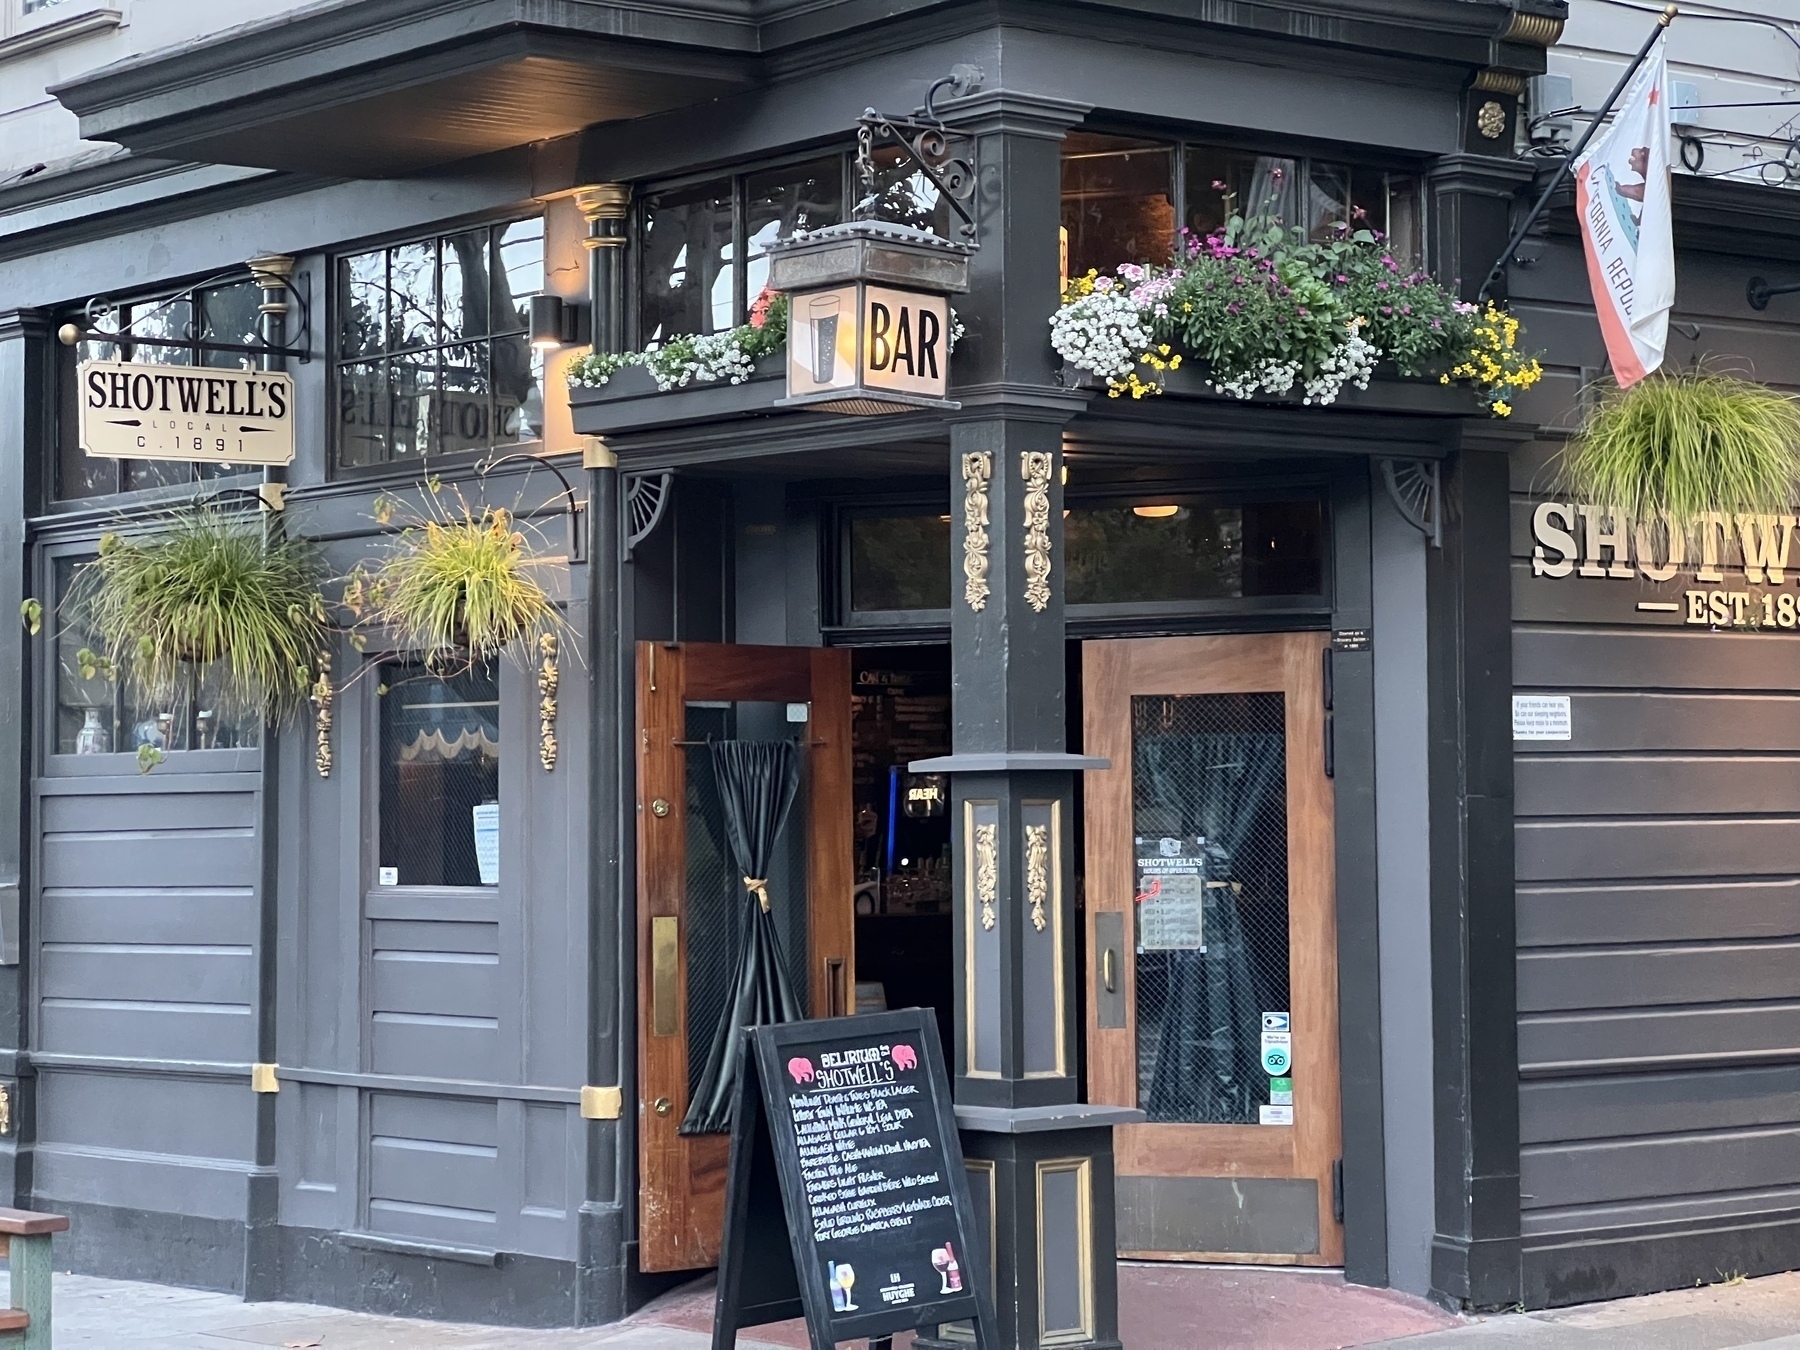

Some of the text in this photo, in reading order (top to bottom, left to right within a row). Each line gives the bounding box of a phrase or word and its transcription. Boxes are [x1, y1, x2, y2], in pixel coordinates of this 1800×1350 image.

[870, 302, 939, 379] BAR
[88, 370, 286, 418] SHOTWELL'S
[152, 420, 227, 433] LOCAL
[1533, 502, 1800, 584] SHOTW
[1762, 593, 1800, 627] 18
[1137, 858, 1203, 867] SHOTWELL'S
[821, 1048, 881, 1068] DELIRIUM
[815, 1060, 894, 1088] SHOTWELL'S
[882, 1287, 916, 1302] HUYGHE
